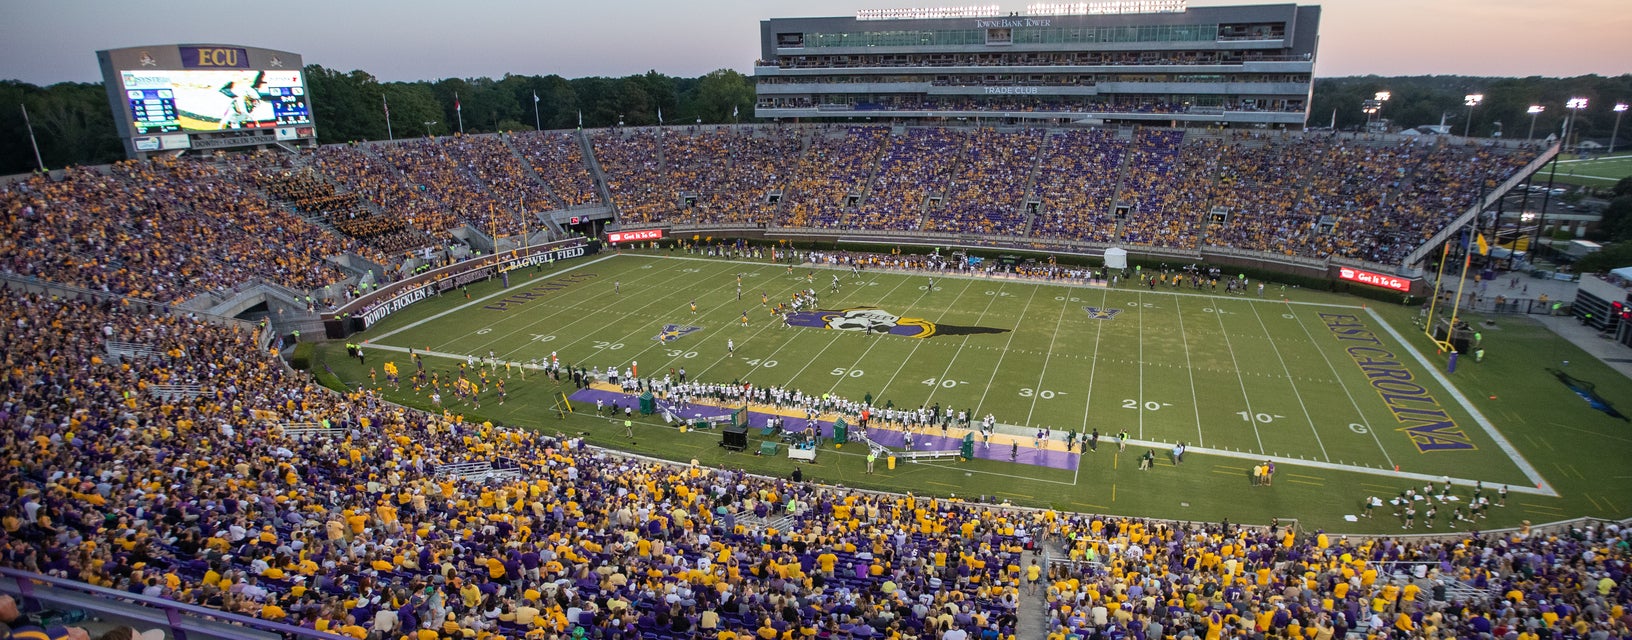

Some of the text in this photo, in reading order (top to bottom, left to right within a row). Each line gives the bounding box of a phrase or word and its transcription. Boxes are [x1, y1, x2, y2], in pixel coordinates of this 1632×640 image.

[198, 48, 238, 66] ECU
[984, 86, 1038, 94] TRADE CLUB
[510, 248, 584, 270] BAGWELL FIELD
[1358, 272, 1372, 282] Get
[1372, 276, 1379, 284] It
[1380, 277, 1389, 286] To
[1390, 280, 1402, 288] Go
[484, 272, 599, 312] PIRATES
[364, 288, 426, 328] DOWDY-FICKLEN
[1317, 311, 1383, 346] EAST
[533, 334, 556, 342] 10
[594, 342, 624, 350] 20
[671, 349, 698, 359] 30
[746, 358, 778, 368] 40
[830, 367, 864, 378] 50
[921, 377, 957, 390] 40
[1018, 388, 1055, 400] 30
[1345, 346, 1478, 454] CAROLINA
[1121, 398, 1161, 412] 20
[1236, 410, 1272, 424] 10
[1348, 422, 1368, 434] G
[1232, 592, 1240, 600] 17
